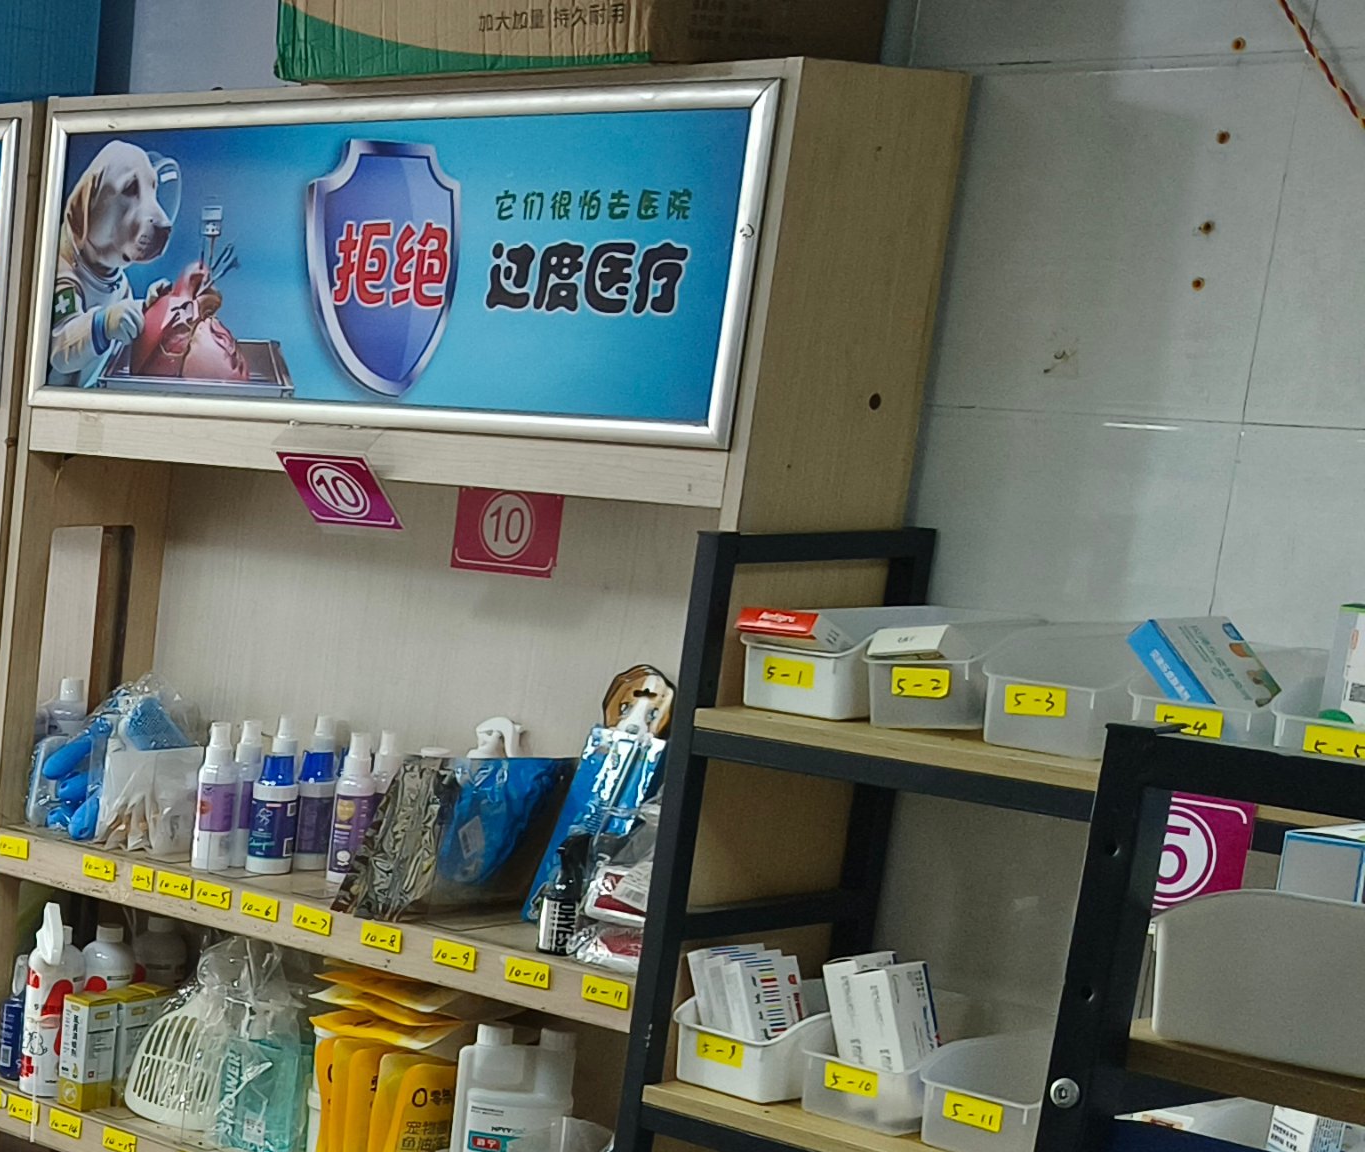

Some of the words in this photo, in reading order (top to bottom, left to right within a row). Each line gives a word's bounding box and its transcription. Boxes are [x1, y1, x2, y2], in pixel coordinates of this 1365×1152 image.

[478, 12, 546, 33] 加大加量
[553, 4, 626, 28] 持久耐用
[494, 188, 693, 224] 它们很怕去医院
[335, 217, 449, 310] 拒绝
[483, 240, 684, 318] 过度医疗
[315, 469, 363, 514] 10
[486, 497, 529, 542] 10
[766, 666, 803, 685] 5-1
[897, 679, 942, 696] 5-2
[1014, 691, 1055, 712] 5-3
[243, 903, 272, 917] 10-6
[297, 915, 329, 930] 10-7
[364, 932, 396, 951] 10-8
[434, 949, 470, 966] 10-9
[508, 966, 546, 985] 10-10
[586, 986, 623, 1002] 10-11
[831, 1073, 873, 1092] 5-10
[951, 1102, 994, 1126] 5-11
